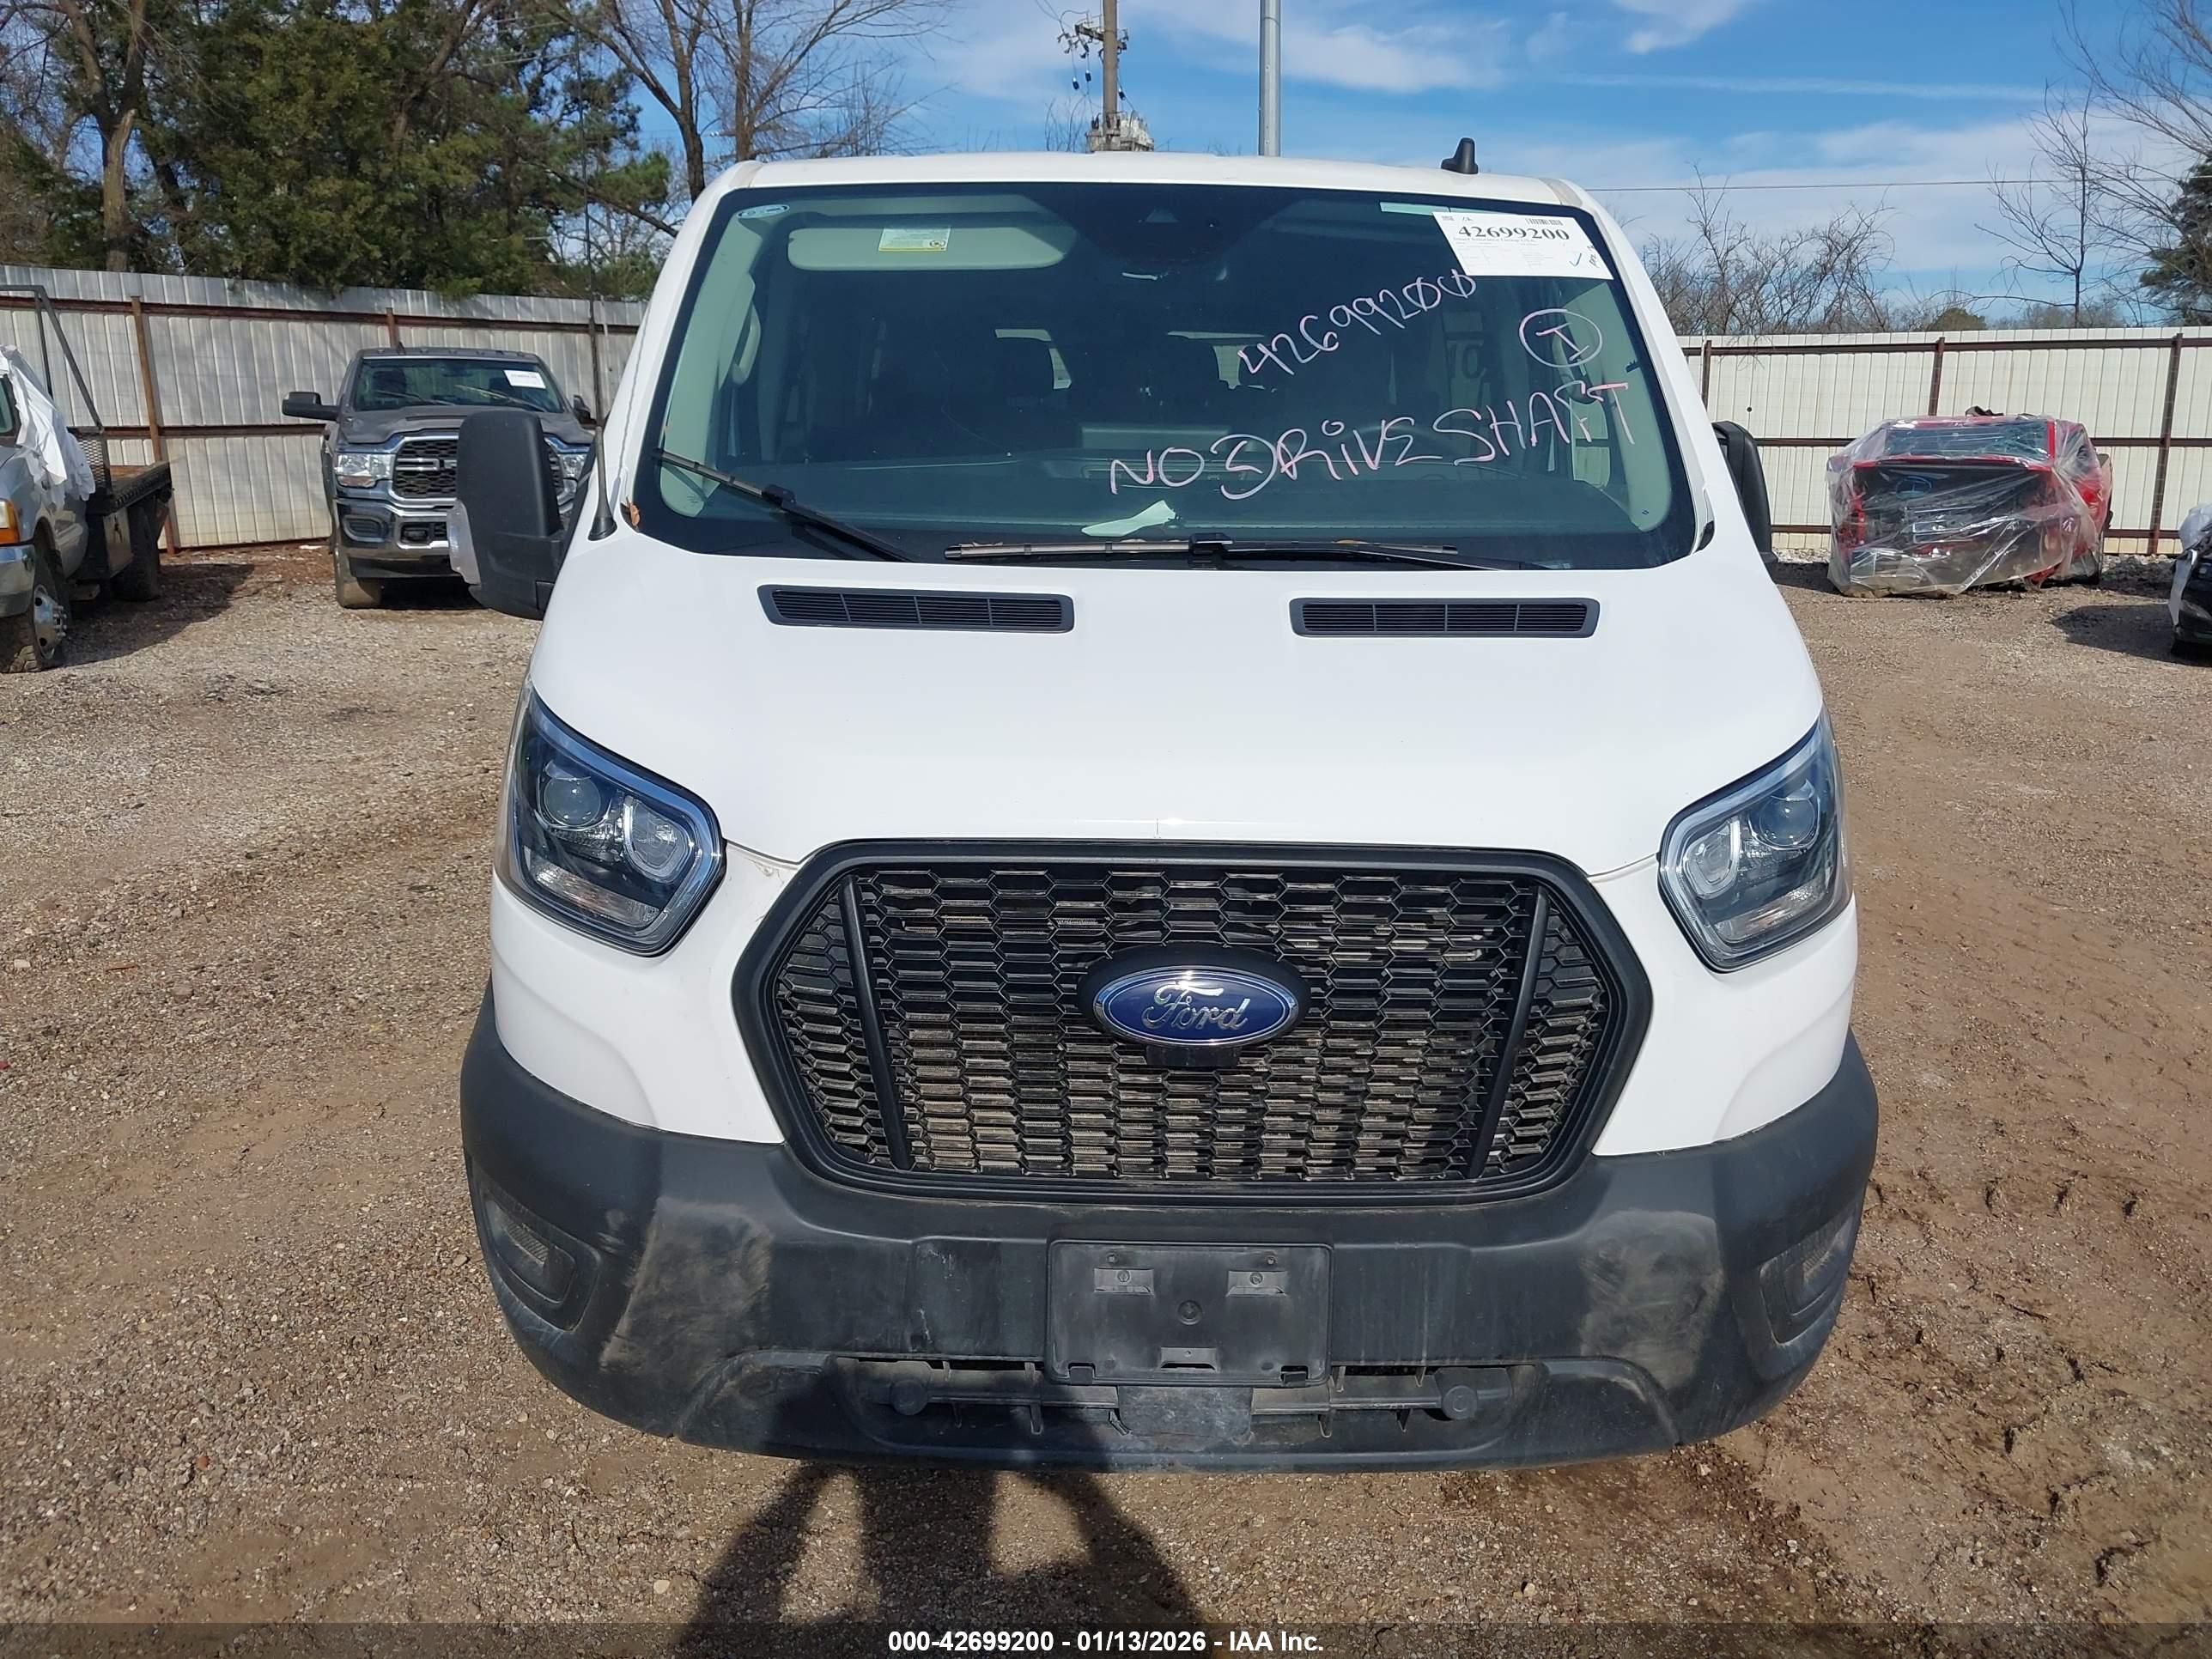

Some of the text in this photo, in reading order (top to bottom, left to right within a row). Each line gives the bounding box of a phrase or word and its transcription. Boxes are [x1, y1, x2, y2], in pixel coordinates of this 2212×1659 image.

[1458, 225, 1570, 241] 42699200
[1237, 268, 1477, 376] 42699200
[1109, 446, 1205, 495] NO
[1432, 380, 1636, 466] SHAFT
[1140, 979, 1250, 1031] Ford
